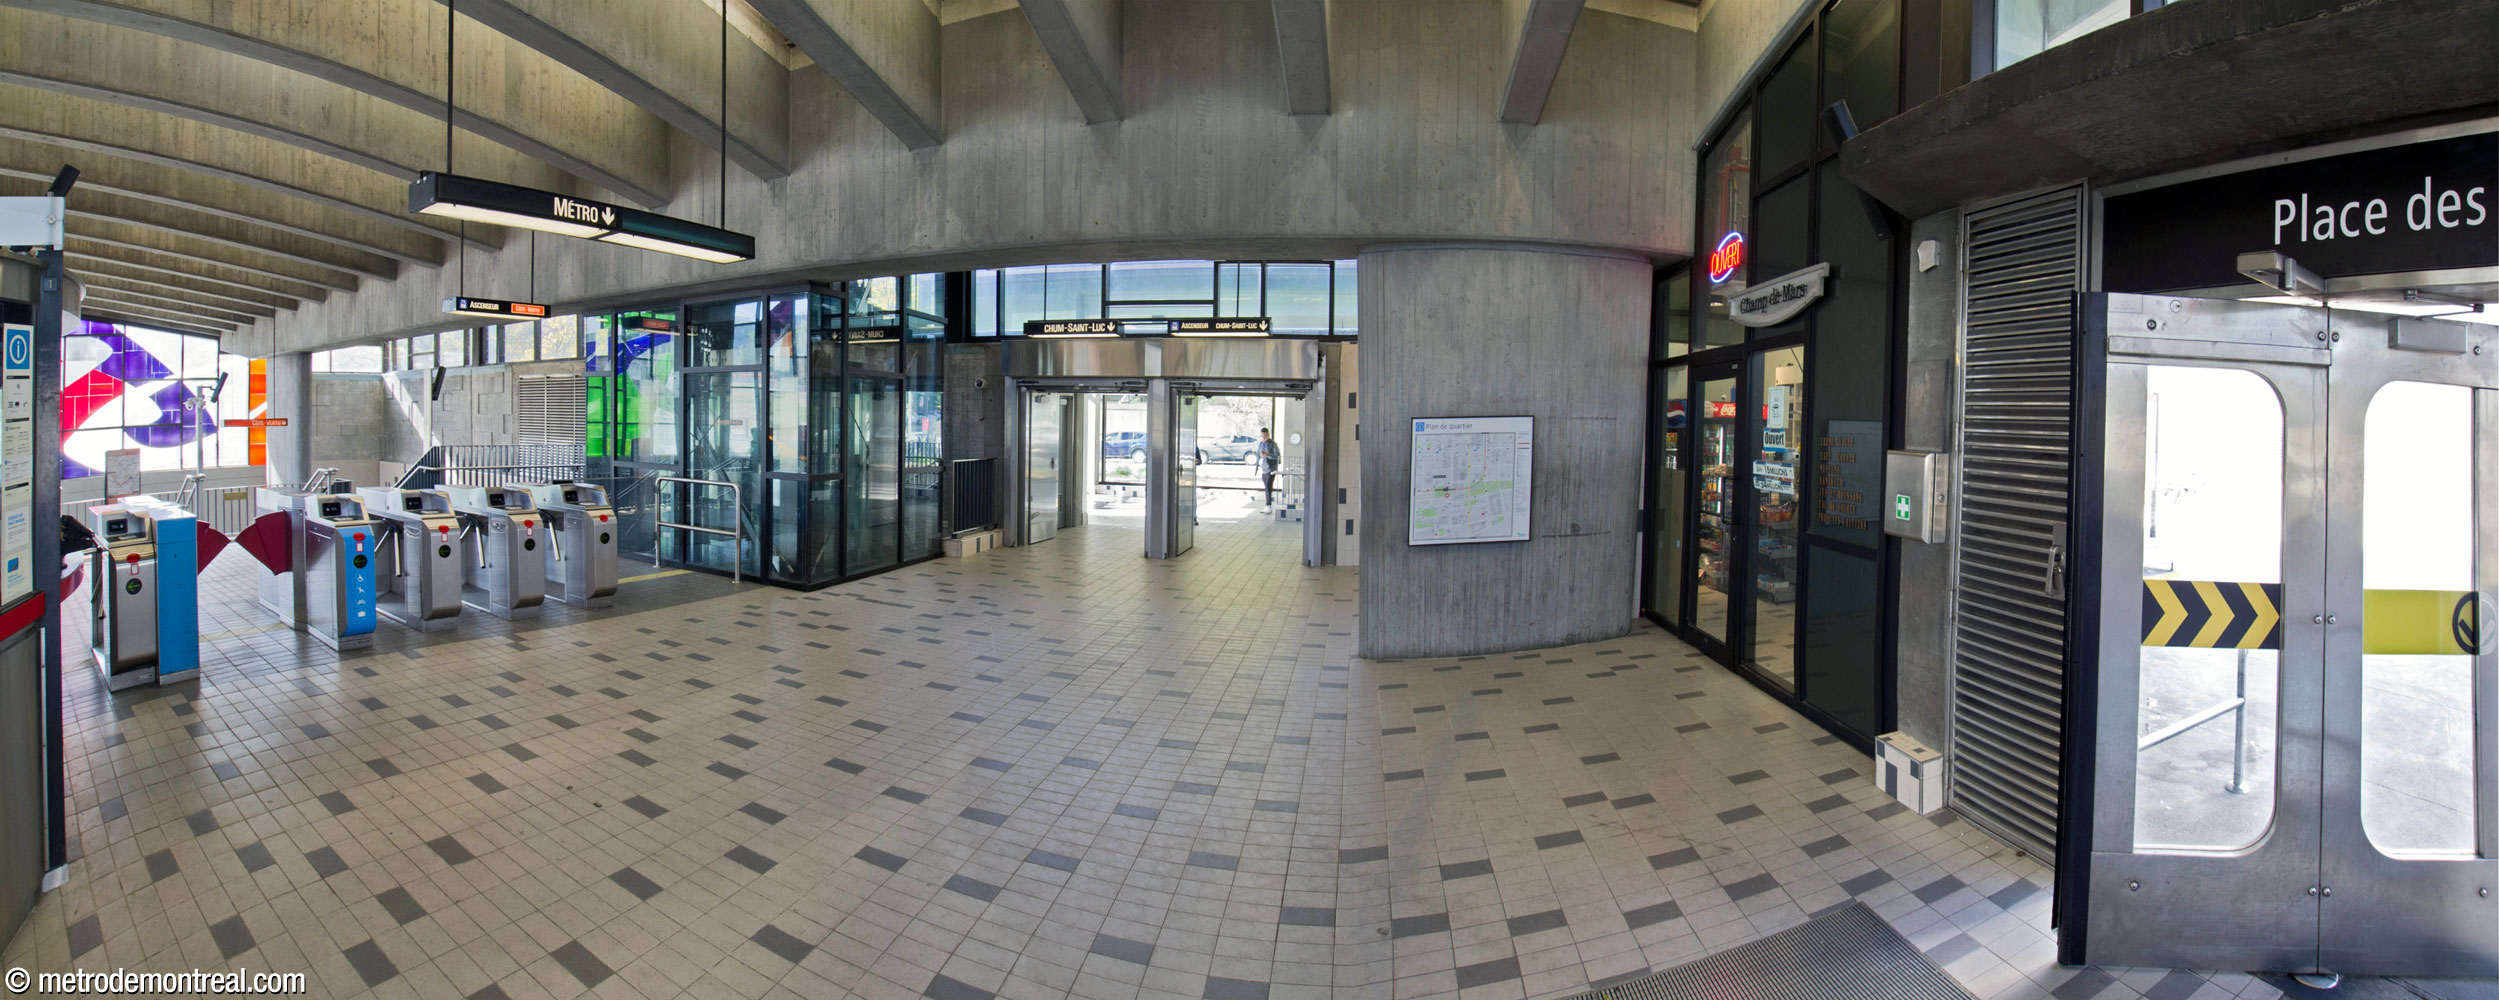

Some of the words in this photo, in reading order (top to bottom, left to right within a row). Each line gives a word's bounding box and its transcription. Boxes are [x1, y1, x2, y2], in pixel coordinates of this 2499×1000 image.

[553, 196, 599, 224] MÉTRO
[2274, 192, 2389, 246] Place
[2406, 175, 2488, 232] des
[1711, 240, 1741, 276] OUVERT
[469, 301, 500, 311] ASCENSEUR
[1740, 296, 1768, 314] Champ
[1044, 321, 1106, 333] CHUM-SAINT-LUC
[1181, 322, 1209, 330] ASCENSEUR
[1215, 321, 1258, 330] CHUM-SAINT-LUC
[1449, 422, 1473, 431] quartier
[1764, 431, 1785, 446] Ouvert
